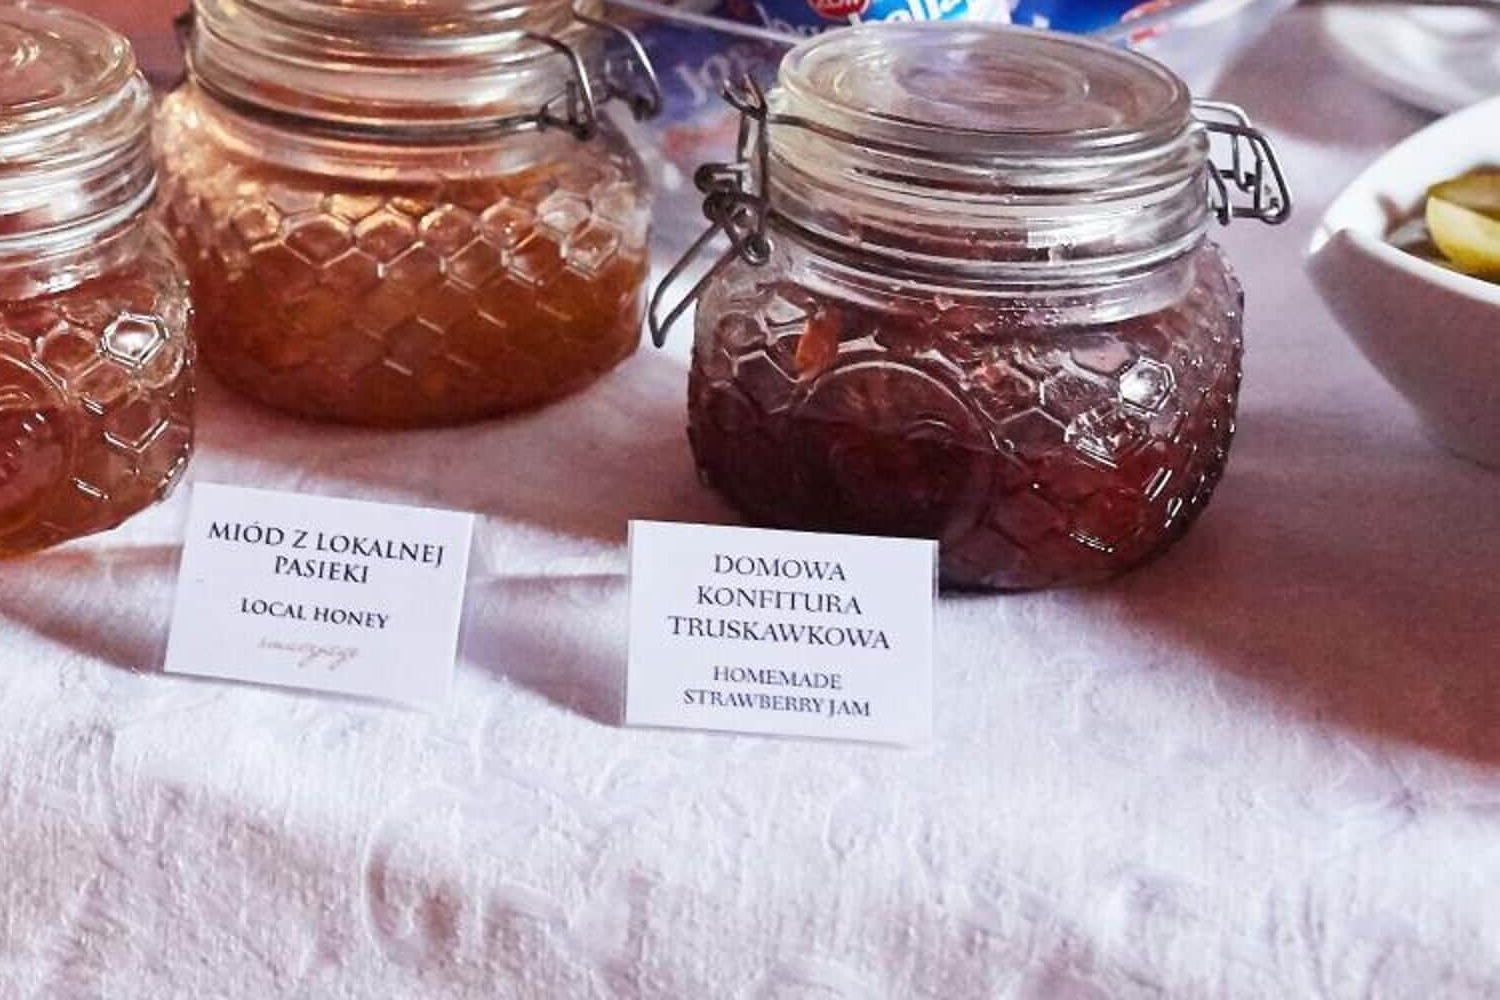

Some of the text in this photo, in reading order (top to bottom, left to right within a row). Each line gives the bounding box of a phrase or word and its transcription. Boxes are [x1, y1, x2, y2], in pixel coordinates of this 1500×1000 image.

[207, 521, 444, 568] MIÓD Z LOKALNEJ
[274, 555, 369, 584] PASIEKI
[714, 554, 847, 582] DOMOWA
[241, 597, 390, 629] LOCAL HONEY
[697, 585, 862, 615] KONFITURA
[668, 615, 890, 650] TRUSKAWKOWA
[712, 665, 843, 690] HOMEMADE
[683, 688, 872, 718] STRAWBERRY JAM
